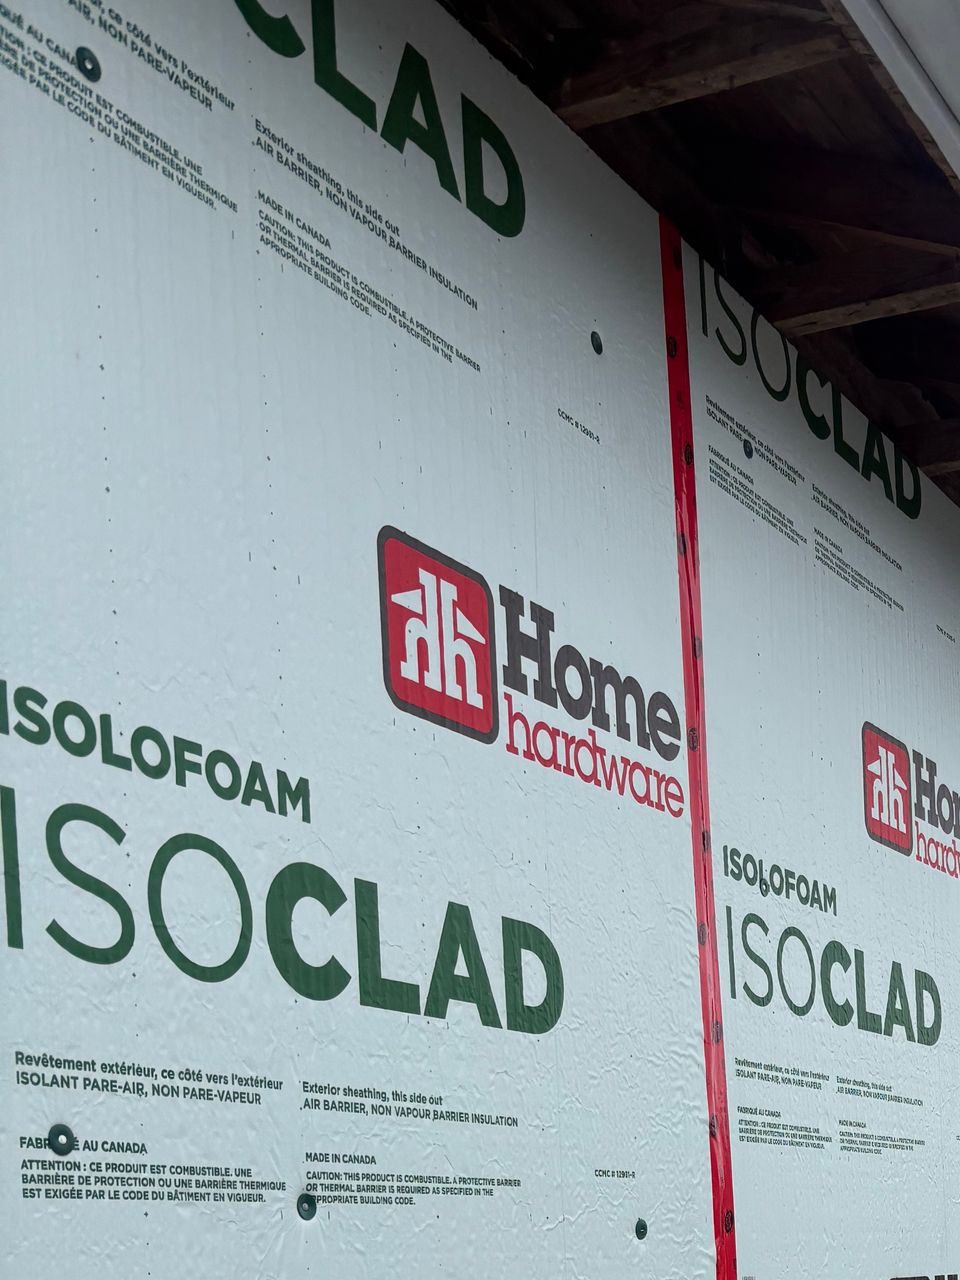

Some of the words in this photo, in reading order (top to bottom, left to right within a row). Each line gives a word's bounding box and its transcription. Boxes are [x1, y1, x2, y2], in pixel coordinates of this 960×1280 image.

[252, 117, 294, 157] Exterior
[295, 152, 345, 199] sheathing,
[346, 189, 364, 210] this
[365, 205, 384, 226] side
[385, 220, 400, 239] out
[253, 135, 273, 158] AIR
[275, 149, 323, 197] BARRIER,
[325, 188, 348, 214] NON
[349, 206, 388, 245] VAPOUR
[388, 236, 428, 275] BARRIER
[428, 266, 478, 311] INSULATION
[499, 584, 682, 762] Home
[0, 681, 311, 823] ISOLOFOAM
[502, 691, 685, 817] hardware
[0, 786, 564, 1034] ISOCLAD
[724, 846, 837, 916] ISOLOFOAM
[726, 906, 942, 1045] ISOCLAD
[302, 1081, 341, 1098] Exterior
[342, 1085, 390, 1103] sheathing,
[391, 1090, 408, 1103] this
[409, 1092, 428, 1105] side
[428, 1094, 443, 1108] out
[302, 1097, 322, 1111] AIR
[323, 1099, 369, 1117] BARRIER,
[371, 1104, 393, 1117] NON
[394, 1106, 432, 1120] VAPOUR
[432, 1109, 470, 1124] BARRIER
[470, 1113, 518, 1127] INSULATION
[304, 1152, 331, 1164] MADE
[331, 1154, 342, 1164] IN
[341, 1154, 377, 1166] CANADA
